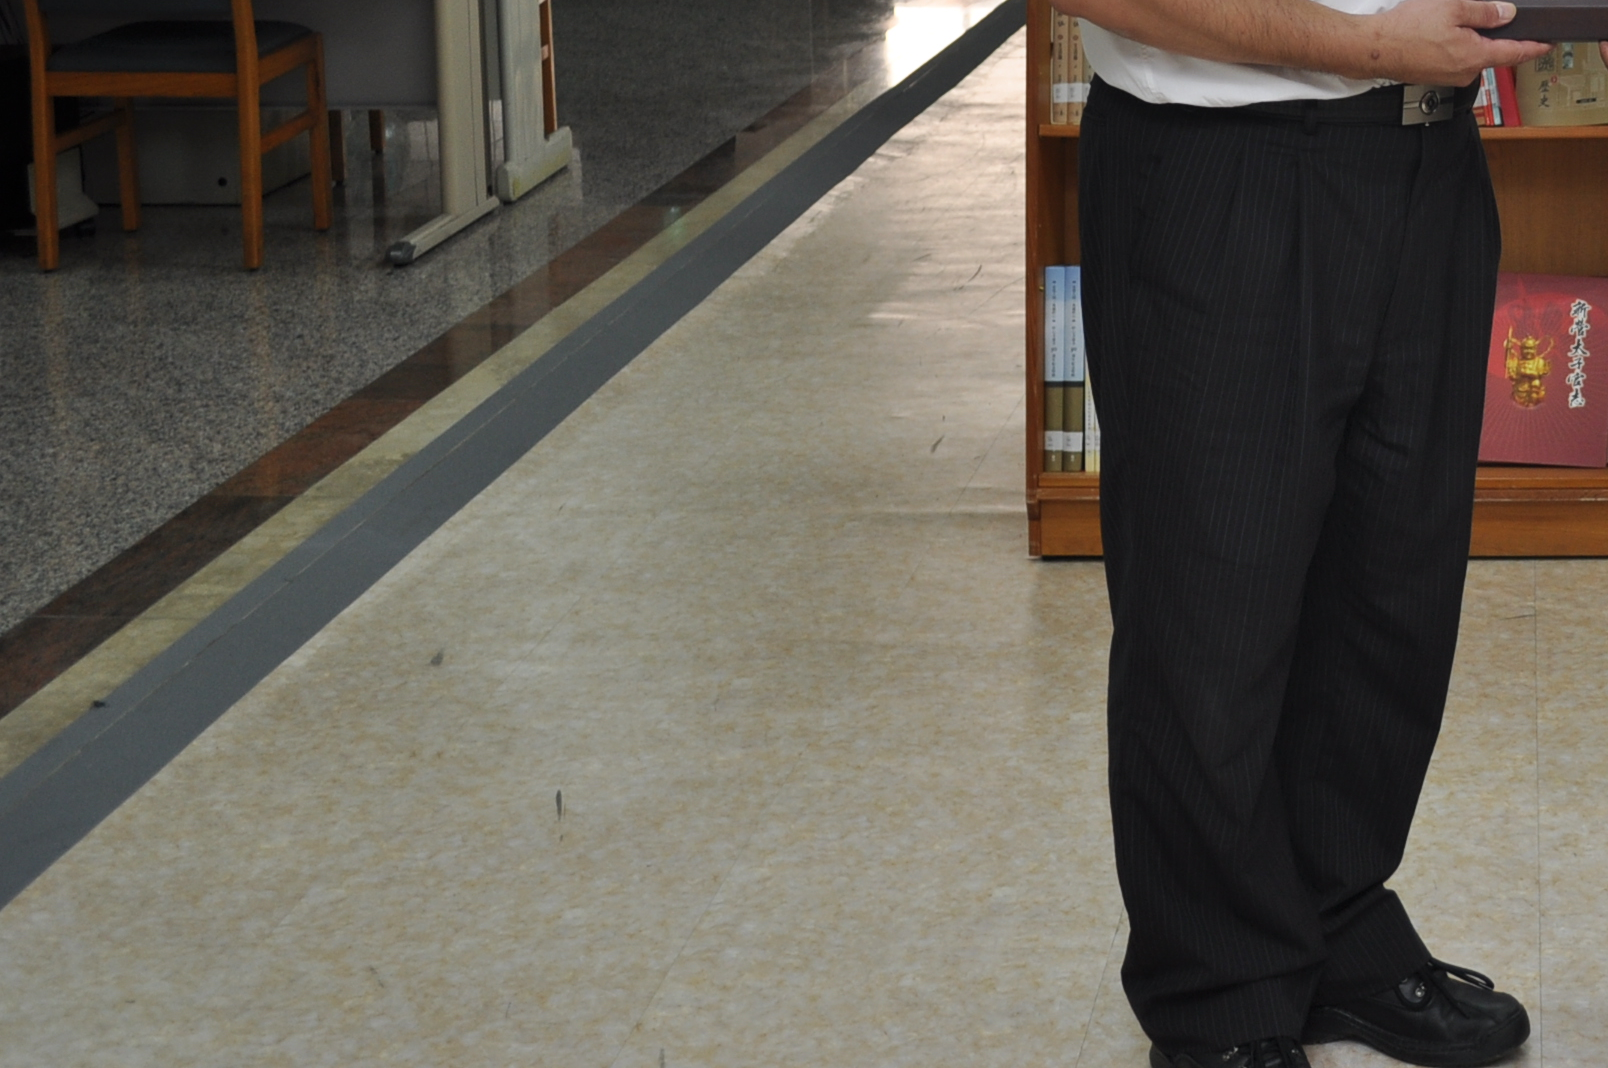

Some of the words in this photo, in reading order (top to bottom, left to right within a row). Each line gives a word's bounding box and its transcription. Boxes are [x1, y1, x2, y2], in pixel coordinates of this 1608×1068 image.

[1566, 299, 1593, 409] 新營太子宮志
